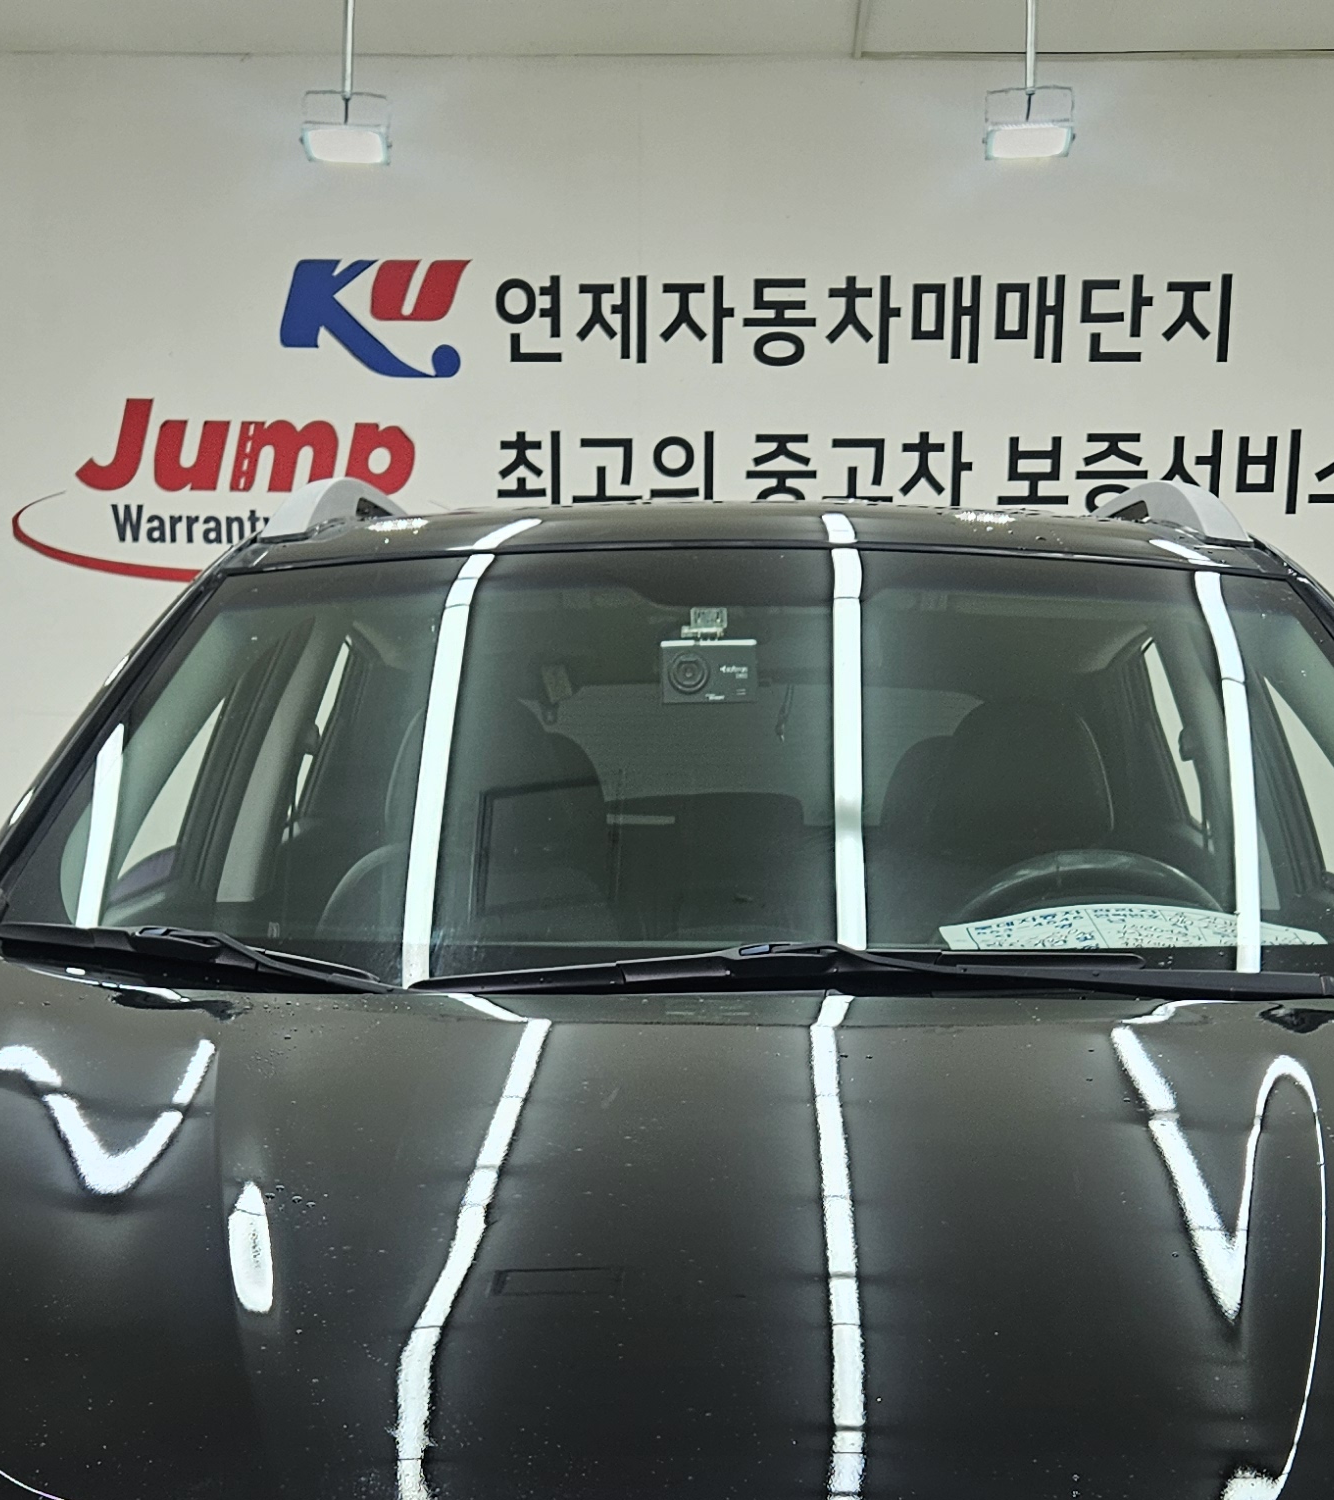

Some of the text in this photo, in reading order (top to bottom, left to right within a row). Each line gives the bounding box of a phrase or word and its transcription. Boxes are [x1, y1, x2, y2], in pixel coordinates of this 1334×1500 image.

[495, 274, 1234, 367] 연제자동차매매단지
[75, 398, 416, 497] Jump
[497, 430, 715, 505] 최고의
[746, 431, 973, 506] 중고차
